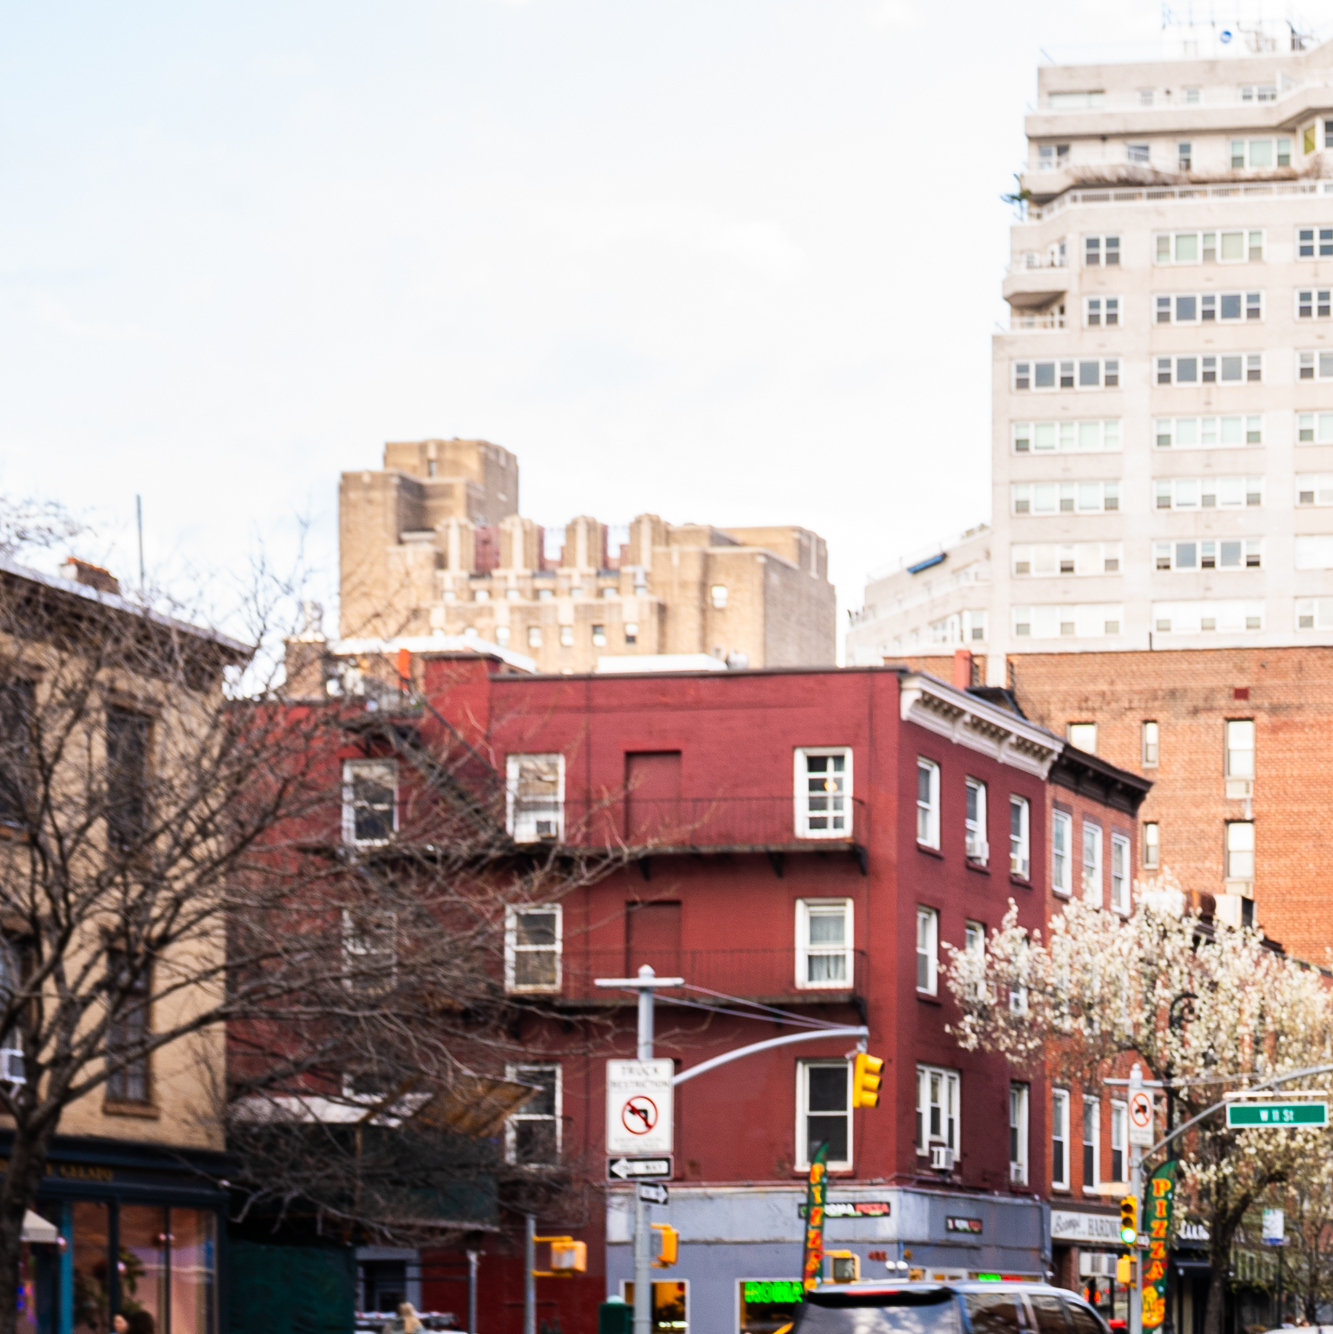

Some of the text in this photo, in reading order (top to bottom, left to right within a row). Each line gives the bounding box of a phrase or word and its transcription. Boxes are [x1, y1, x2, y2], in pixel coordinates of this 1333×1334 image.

[1282, 1108, 1295, 1122] St
[1145, 1178, 1172, 1280] PIZZA
[744, 1280, 804, 1304] ROMA
